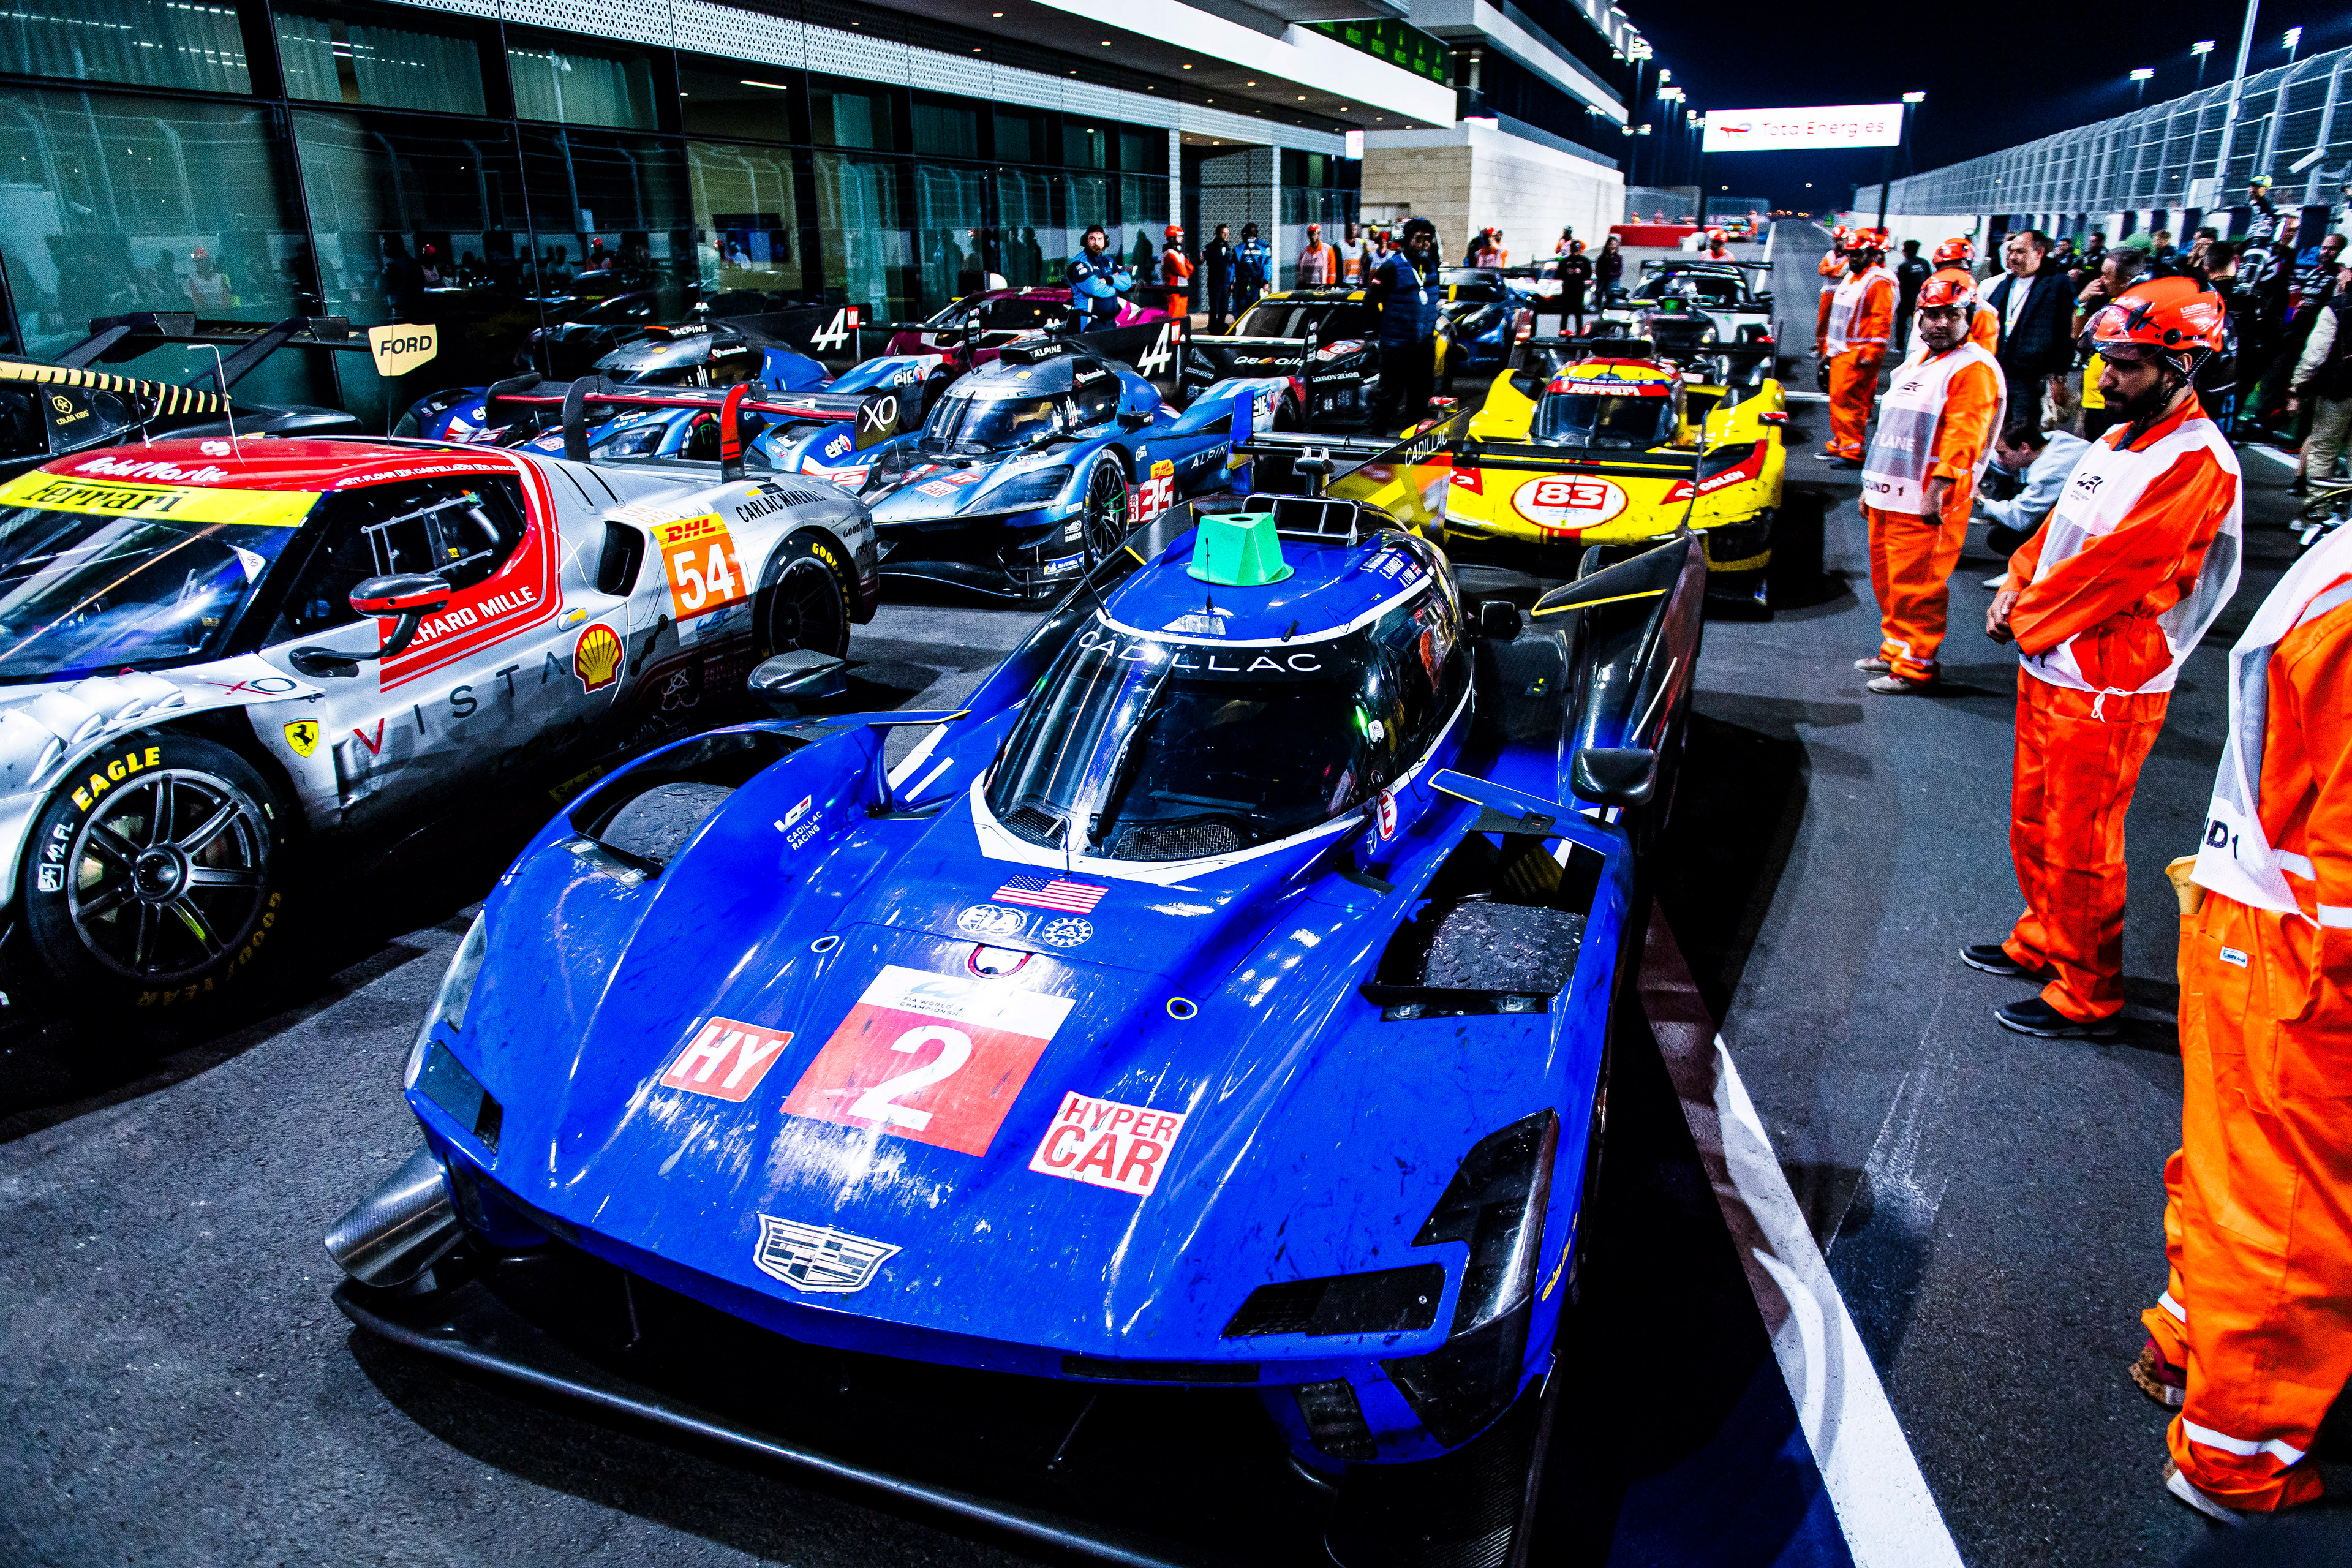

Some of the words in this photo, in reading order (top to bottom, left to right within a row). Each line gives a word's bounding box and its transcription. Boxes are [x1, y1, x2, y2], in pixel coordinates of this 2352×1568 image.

[1761, 120, 1884, 137] TotalEnergies
[848, 311, 858, 326] HY
[674, 325, 707, 336] ALPINE
[1172, 324, 1180, 341] HY
[380, 335, 432, 356] FORD
[1034, 344, 1061, 358] ALPINE
[1184, 366, 1215, 379] innovation
[1312, 371, 1360, 383] innovation
[1567, 383, 1642, 396] Ferrari
[56, 415, 77, 426] COLOR
[74, 410, 89, 420] KIDS
[863, 395, 897, 434] XO
[825, 438, 845, 459] elf
[1405, 427, 1449, 467] CADILLAC
[1880, 433, 1915, 452] LANE
[1191, 442, 1229, 469] ALPIN
[946, 472, 978, 484] HY
[1154, 463, 1170, 475] DHL
[1700, 470, 1745, 491] ORLEN
[21, 480, 190, 512] Ferrari
[923, 484, 948, 497] CAR
[1537, 483, 1604, 506] 83
[1898, 486, 1905, 496] 1
[736, 496, 783, 523] CARLAC
[665, 519, 716, 543] DHL
[673, 543, 736, 610] 54
[477, 586, 537, 618] MILLE
[1079, 630, 1322, 673] CADILLAC
[353, 650, 567, 754] VISTA
[71, 747, 160, 812] EAGLE
[786, 811, 823, 843] CADILLAC
[1379, 794, 1393, 837] E
[53, 822, 74, 840] FL
[791, 824, 820, 850] RACING
[2231, 834, 2239, 860] 1
[921, 1000, 952, 1009] WORLD
[669, 1024, 785, 1090] HY
[847, 1025, 973, 1131] 2
[1065, 1098, 1178, 1143] HYPER
[1043, 1125, 1163, 1187] CAR
